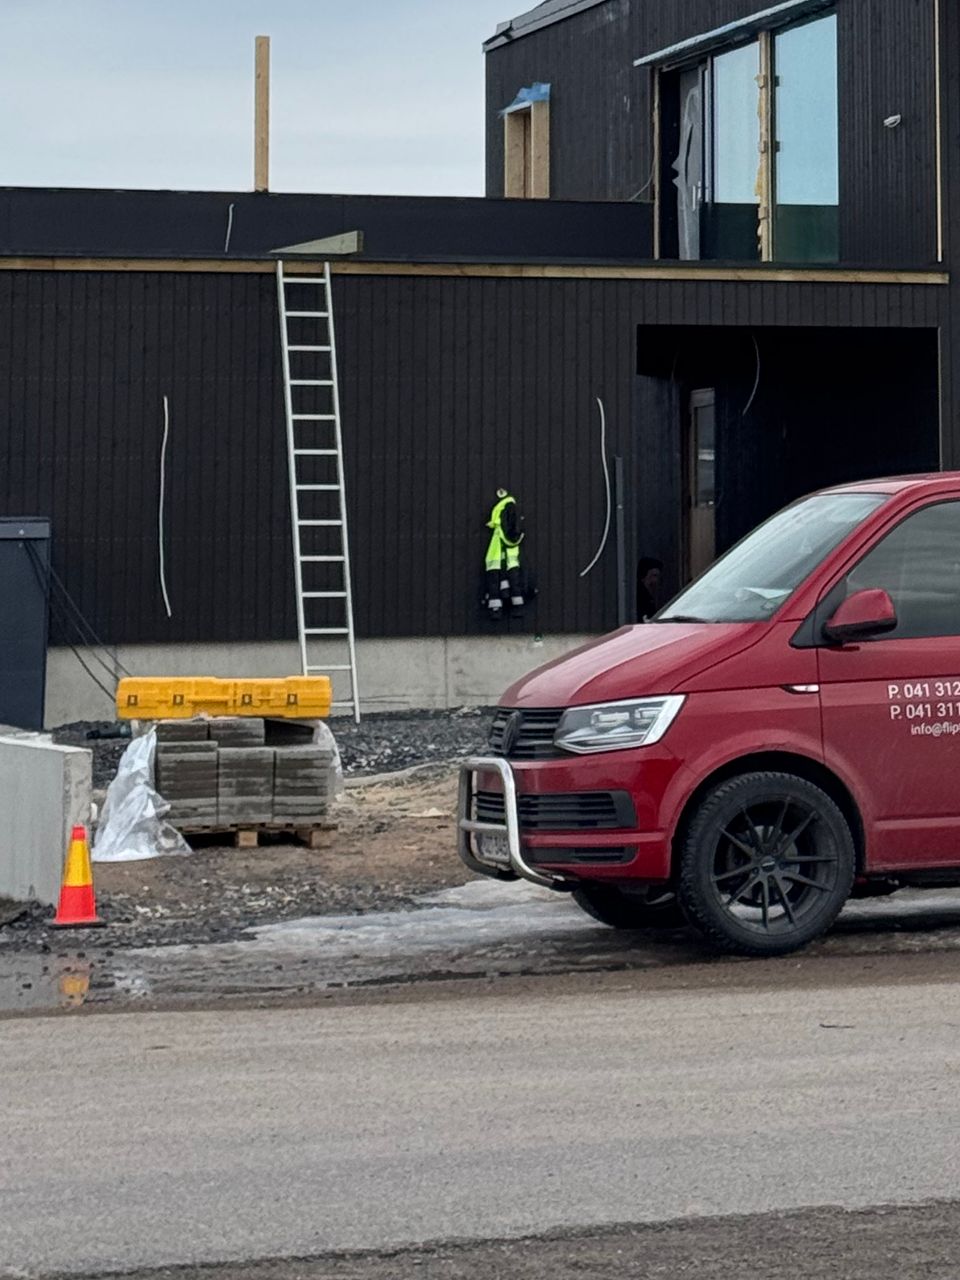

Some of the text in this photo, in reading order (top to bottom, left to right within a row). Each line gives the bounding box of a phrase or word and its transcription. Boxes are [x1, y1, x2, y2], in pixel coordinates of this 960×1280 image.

[888, 684, 901, 699] P.
[904, 683, 930, 698] 041
[890, 705, 903, 720] P.
[906, 704, 932, 719] 041
